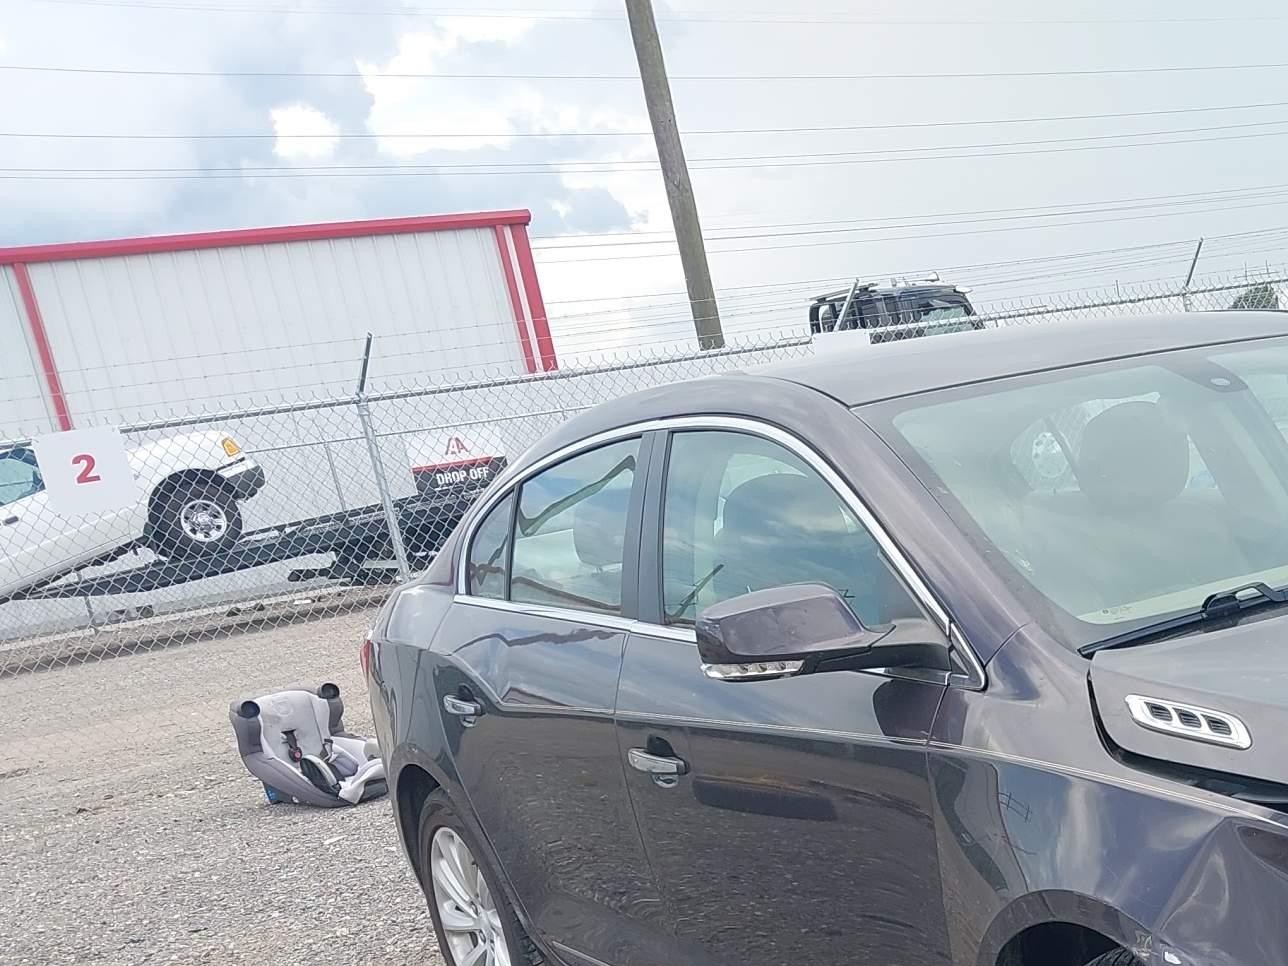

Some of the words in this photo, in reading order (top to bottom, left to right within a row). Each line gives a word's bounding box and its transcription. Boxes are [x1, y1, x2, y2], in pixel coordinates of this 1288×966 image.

[72, 454, 101, 484] 2
[436, 469, 467, 485] DROP
[469, 466, 489, 480] OFF
